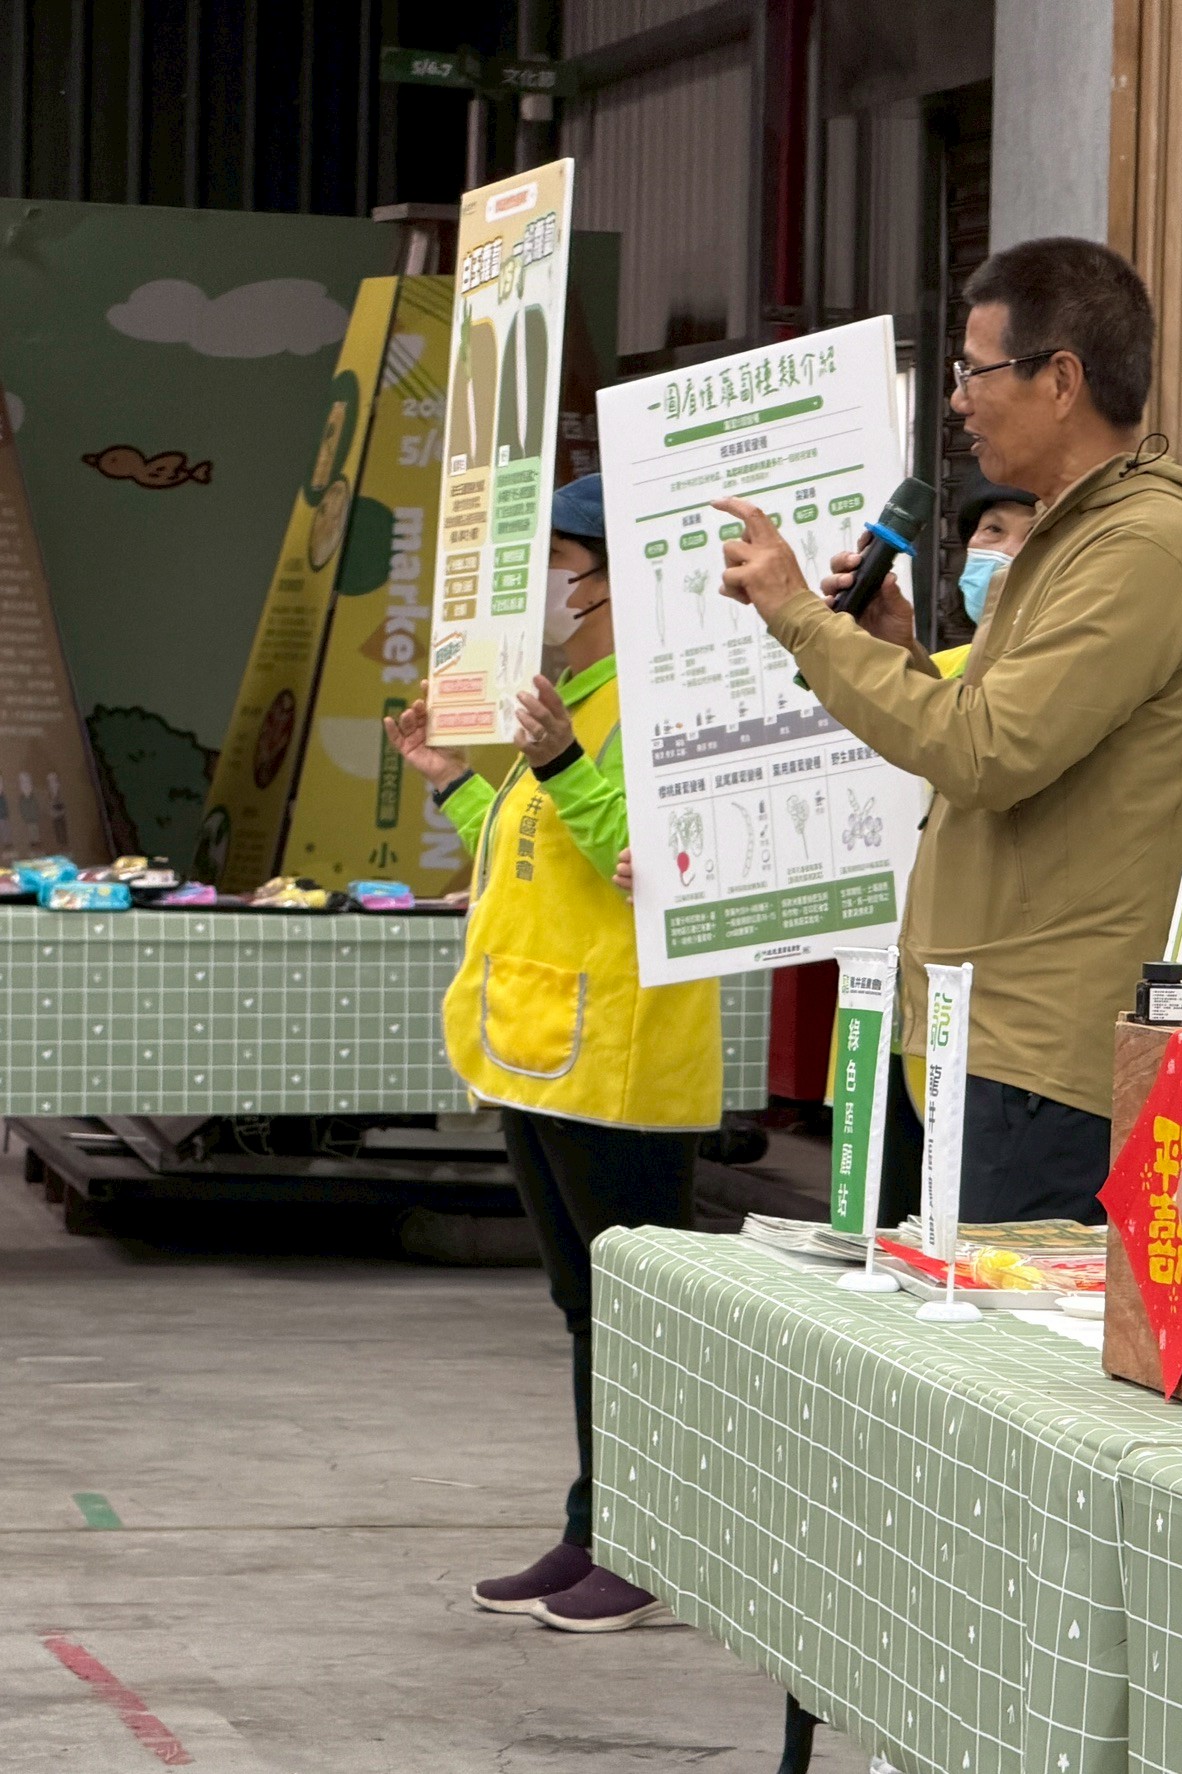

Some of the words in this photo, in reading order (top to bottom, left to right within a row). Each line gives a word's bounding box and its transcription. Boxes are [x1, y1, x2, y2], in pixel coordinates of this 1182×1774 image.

[646, 346, 838, 420] 一圖看懂蘿蔔種類介紹
[382, 506, 428, 686] market
[837, 1018, 861, 1218] 綠色照顧站
